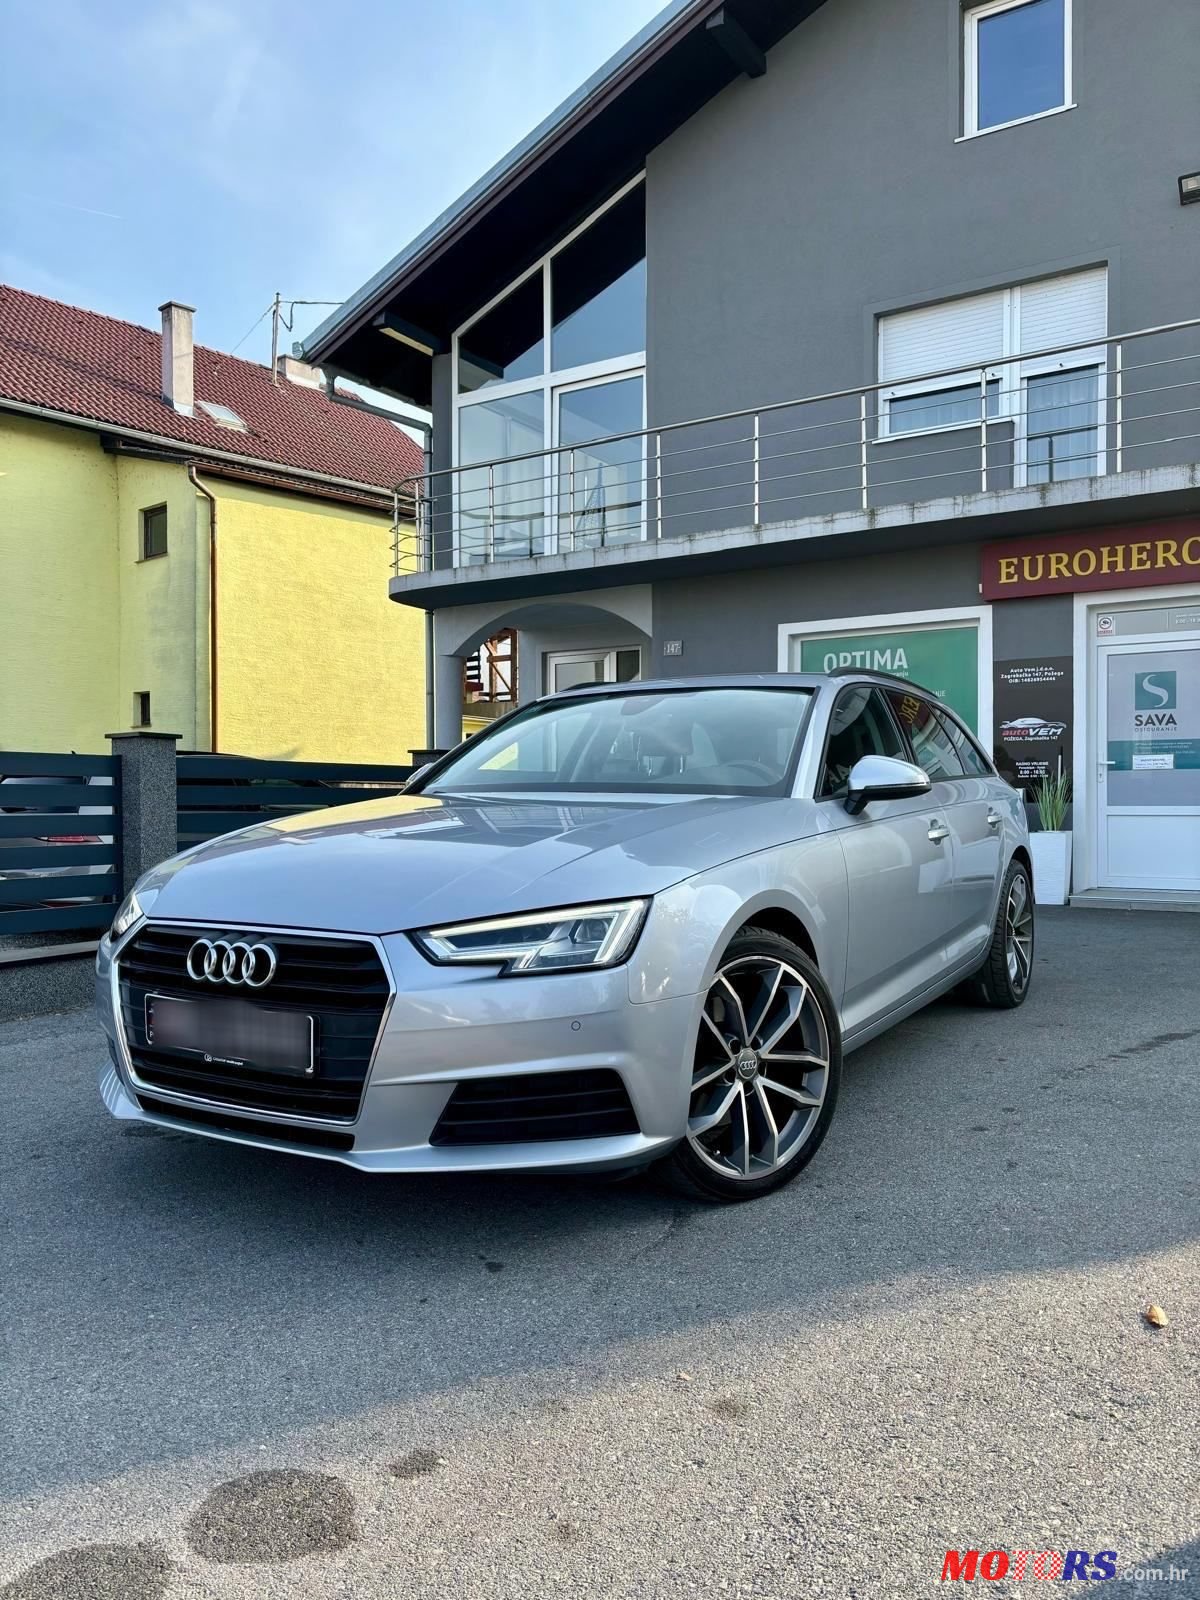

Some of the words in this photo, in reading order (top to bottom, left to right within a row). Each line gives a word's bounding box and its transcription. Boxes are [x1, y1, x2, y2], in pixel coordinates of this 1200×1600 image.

[998, 536, 1200, 584] EUROHERC
[823, 648, 909, 674] OPTIMA
[1134, 713, 1177, 726] SAVA
